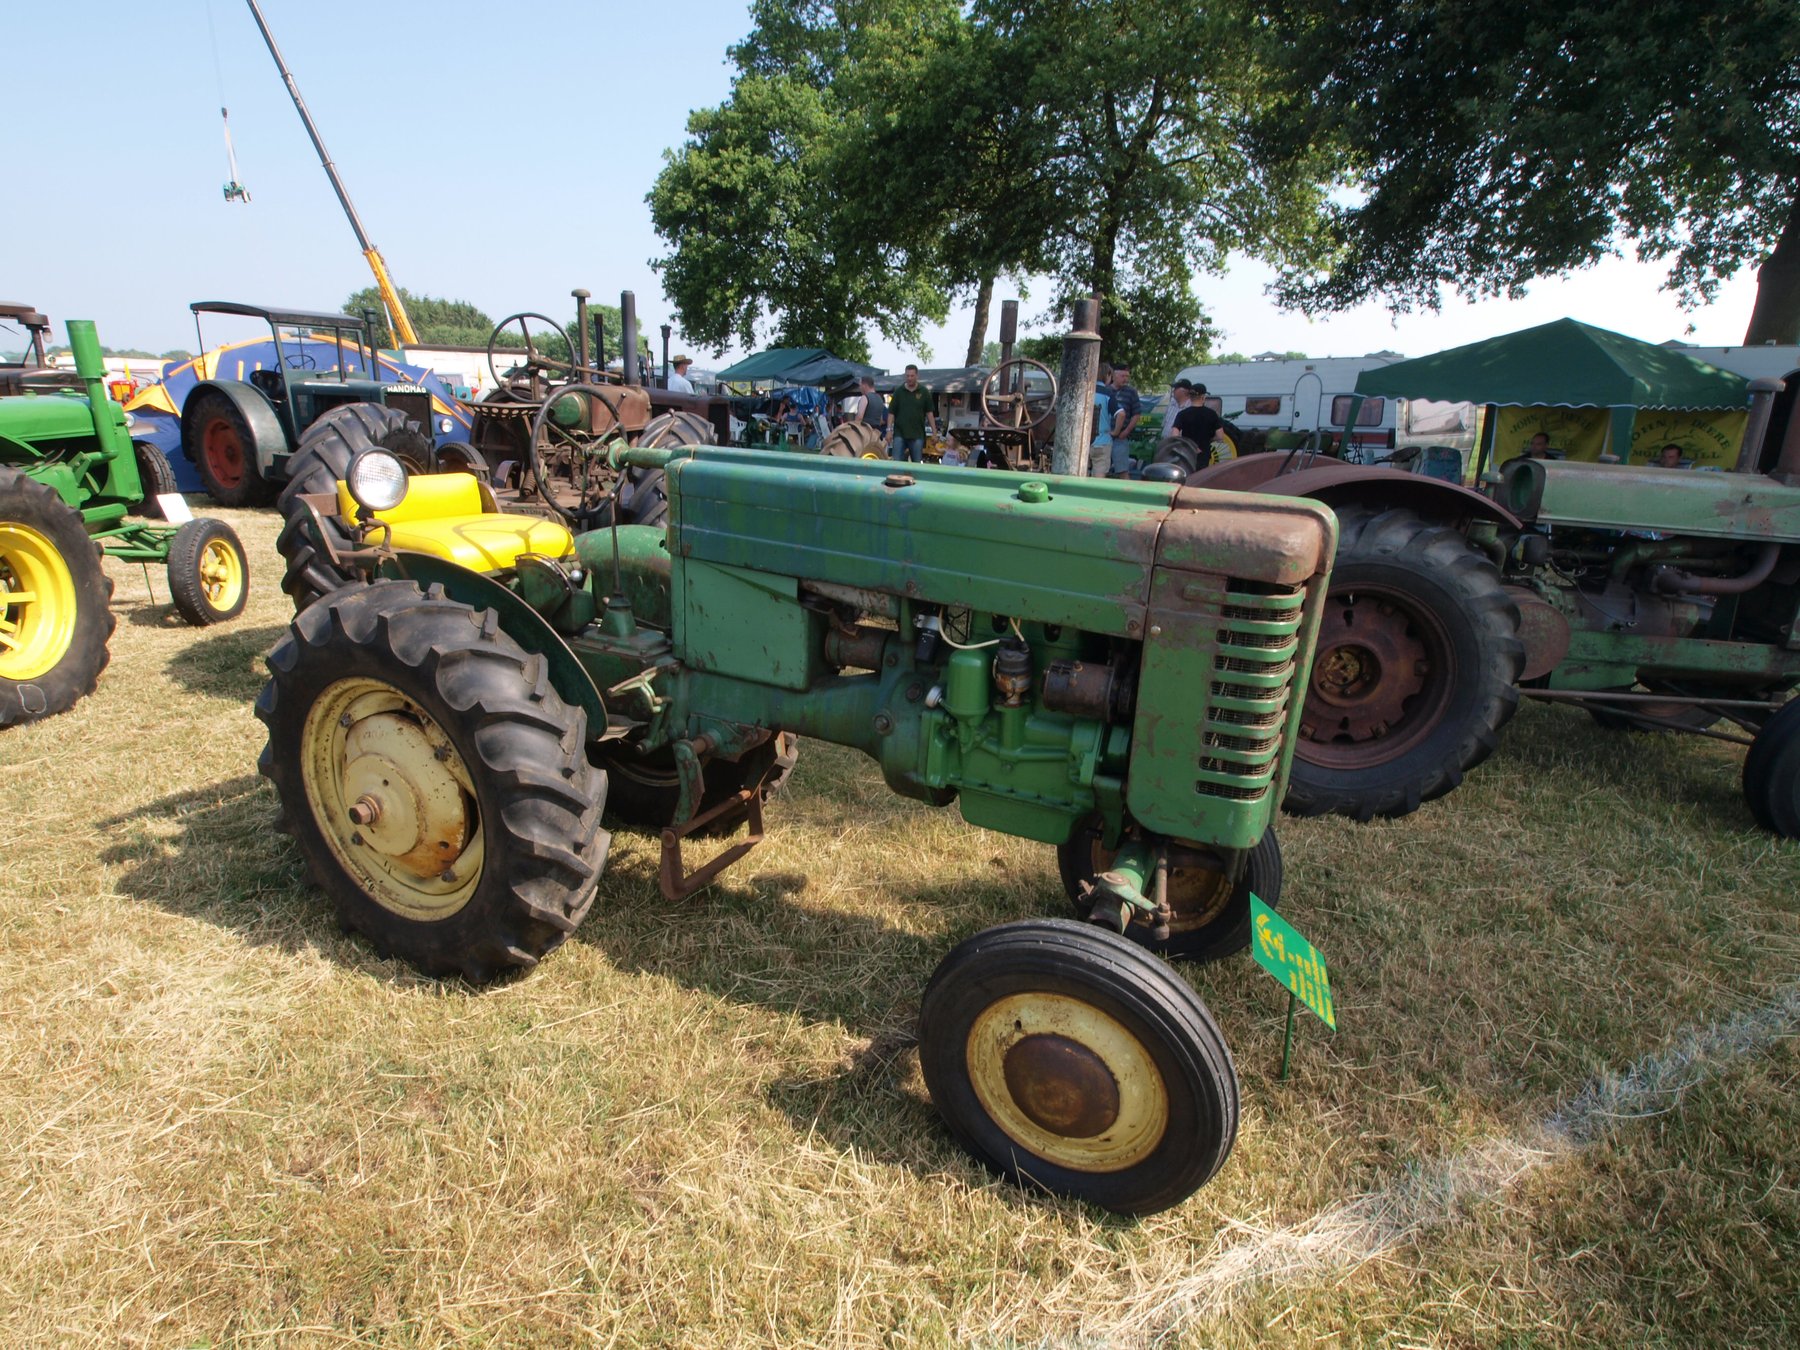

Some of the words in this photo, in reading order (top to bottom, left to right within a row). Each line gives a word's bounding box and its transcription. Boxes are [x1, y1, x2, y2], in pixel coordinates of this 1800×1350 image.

[387, 385, 427, 393] HANOMAG
[1631, 419, 1666, 443] OHN
[1690, 418, 1730, 449] DEERE
